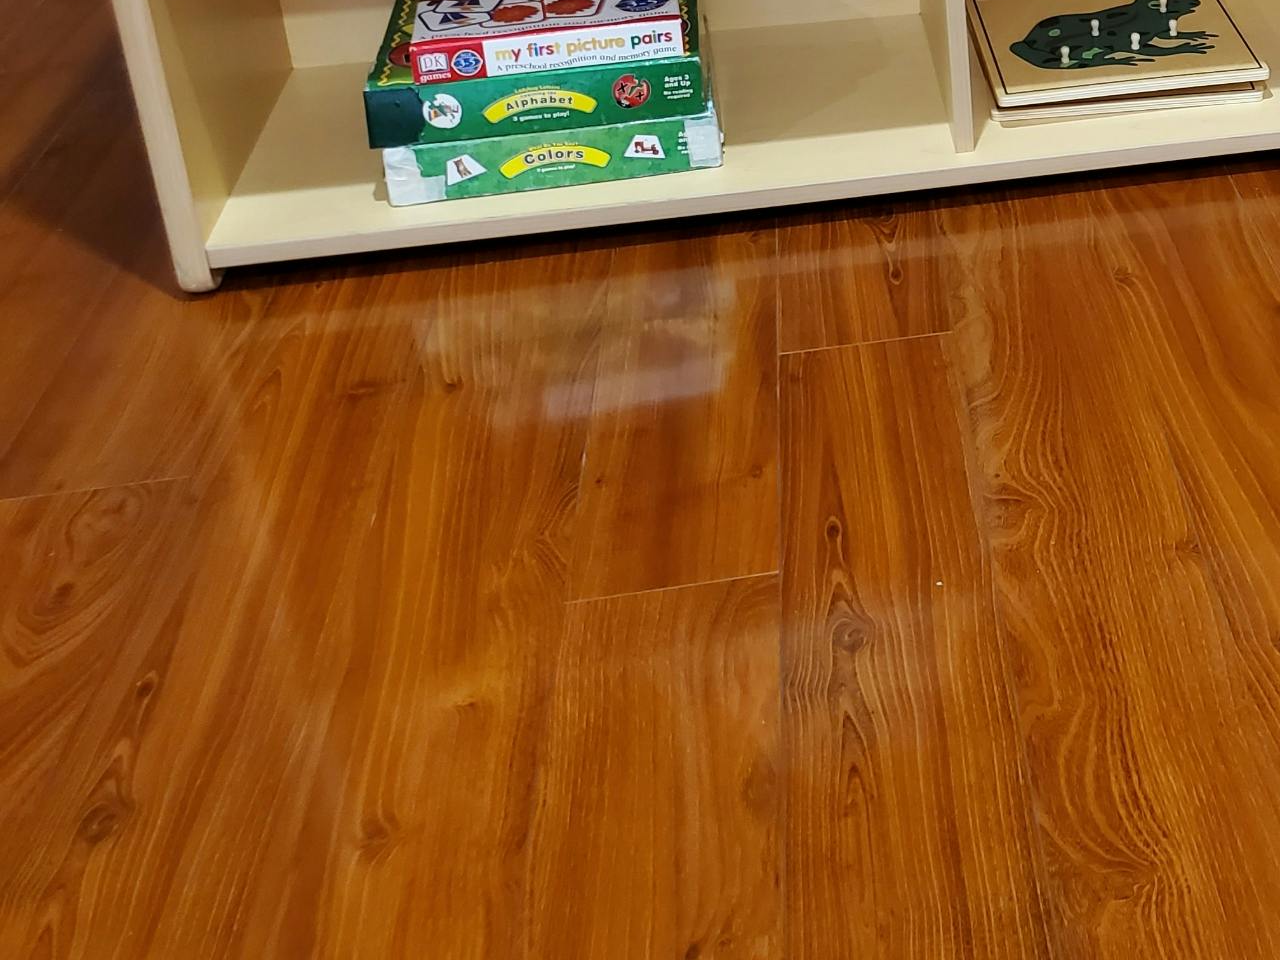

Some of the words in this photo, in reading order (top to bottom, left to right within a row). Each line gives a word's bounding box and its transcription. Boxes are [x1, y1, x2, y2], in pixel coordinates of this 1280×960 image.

[494, 47, 522, 63] my
[525, 41, 561, 58] first
[565, 35, 626, 56] picture
[630, 29, 673, 50] pairs
[422, 55, 446, 70] DK
[496, 64, 503, 72] A
[505, 61, 548, 73] preschool
[548, 54, 597, 70] recognition
[599, 54, 617, 62] and
[618, 49, 651, 61] memory
[652, 46, 677, 56] game
[419, 72, 452, 83] games
[664, 75, 683, 83] Ages
[664, 81, 679, 89] and
[679, 80, 691, 88] Up
[505, 95, 574, 112] Alphabet
[518, 114, 543, 122] games
[552, 110, 570, 119] play!
[524, 149, 584, 165] Colors
